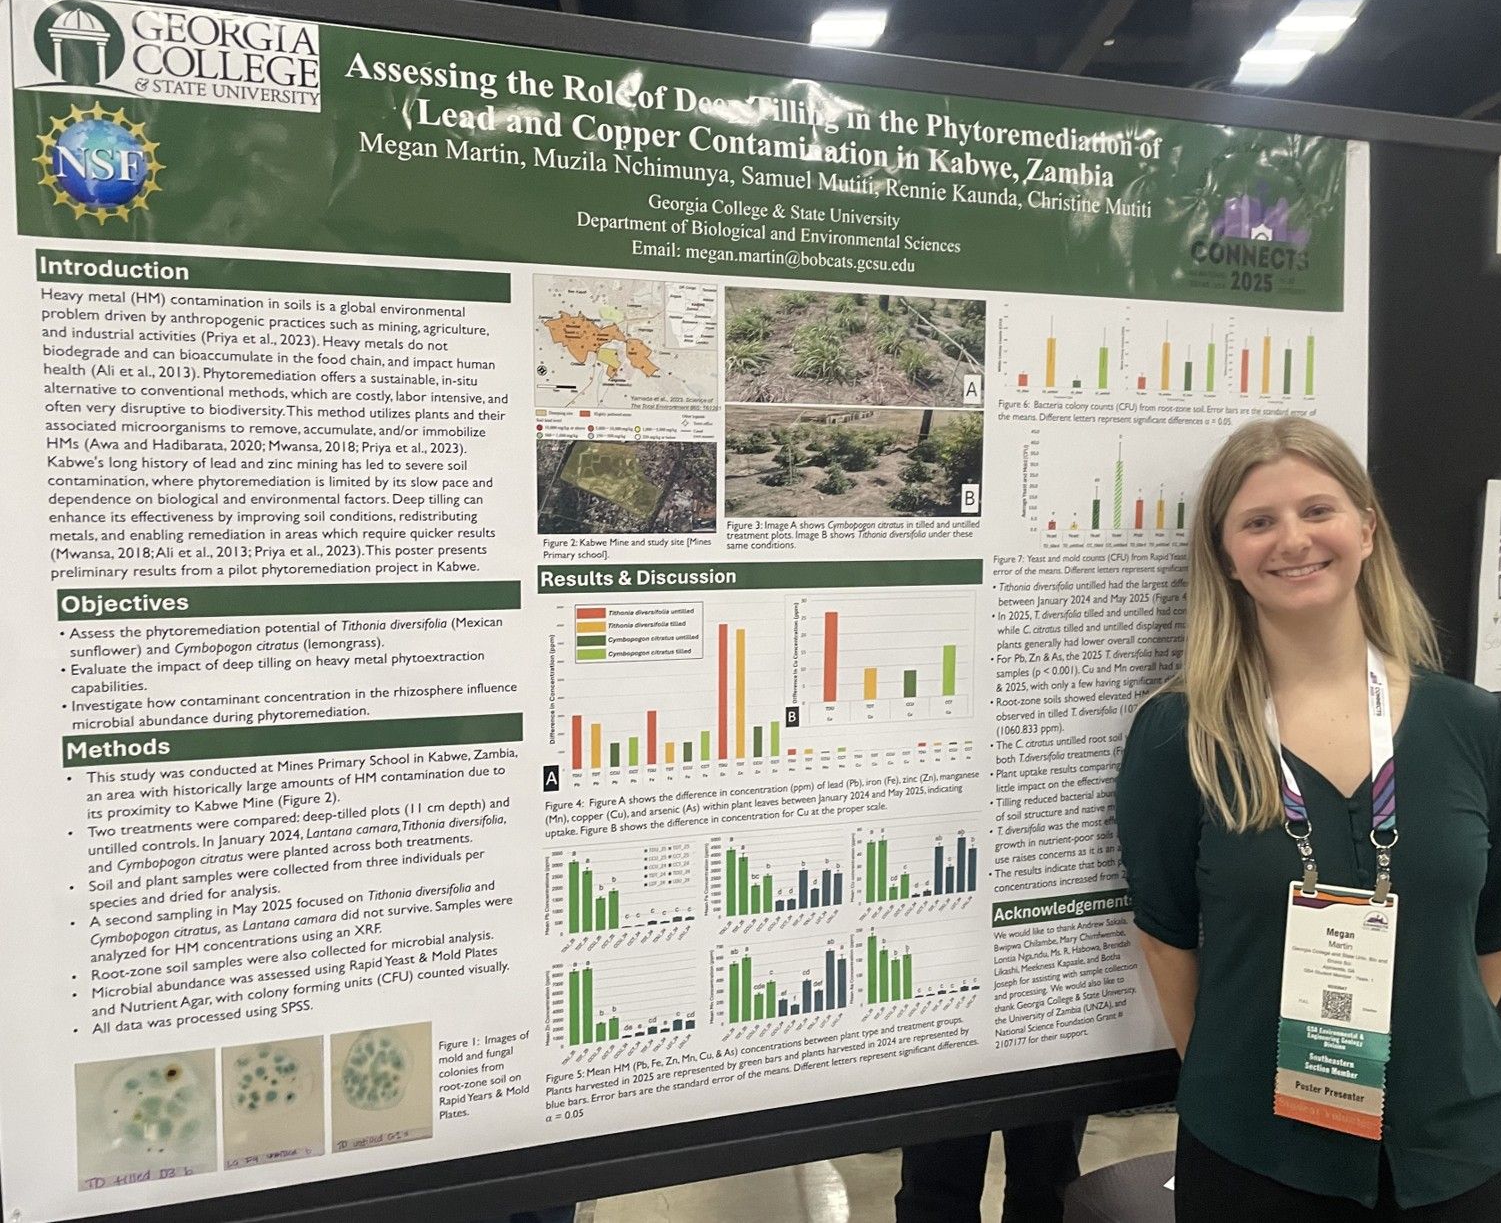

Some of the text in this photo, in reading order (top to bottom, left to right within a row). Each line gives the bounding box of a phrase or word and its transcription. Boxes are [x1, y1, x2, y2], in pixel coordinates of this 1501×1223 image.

[131, 10, 317, 56] GEORGIA
[132, 44, 319, 89] COLLEGE
[135, 78, 321, 106] & STATE UNIVERSITY
[345, 52, 498, 99] Assessing
[506, 70, 554, 98] the
[639, 85, 668, 110] of
[846, 109, 870, 131] in
[879, 110, 918, 135] the
[926, 113, 1134, 158] Phytoremediation
[1139, 136, 1163, 161] of
[417, 99, 1114, 188] Lead and Copper Contamination in Kabwe, Zambia
[56, 145, 144, 181] NSF
[39, 256, 189, 281] Introduction
[1190, 241, 1309, 271] CONNECTS
[1230, 271, 1273, 292] 2025
[41, 287, 466, 317] Heavy metal (HM) contamination in soils is a global environmental
[540, 569, 737, 586] Results & Discussion
[61, 594, 189, 616] Objectives
[66, 738, 170, 759] Methods
[1326, 927, 1355, 940] Megan
[1328, 940, 1353, 951] Martin
[1295, 1081, 1365, 1103] Poster Presenter
